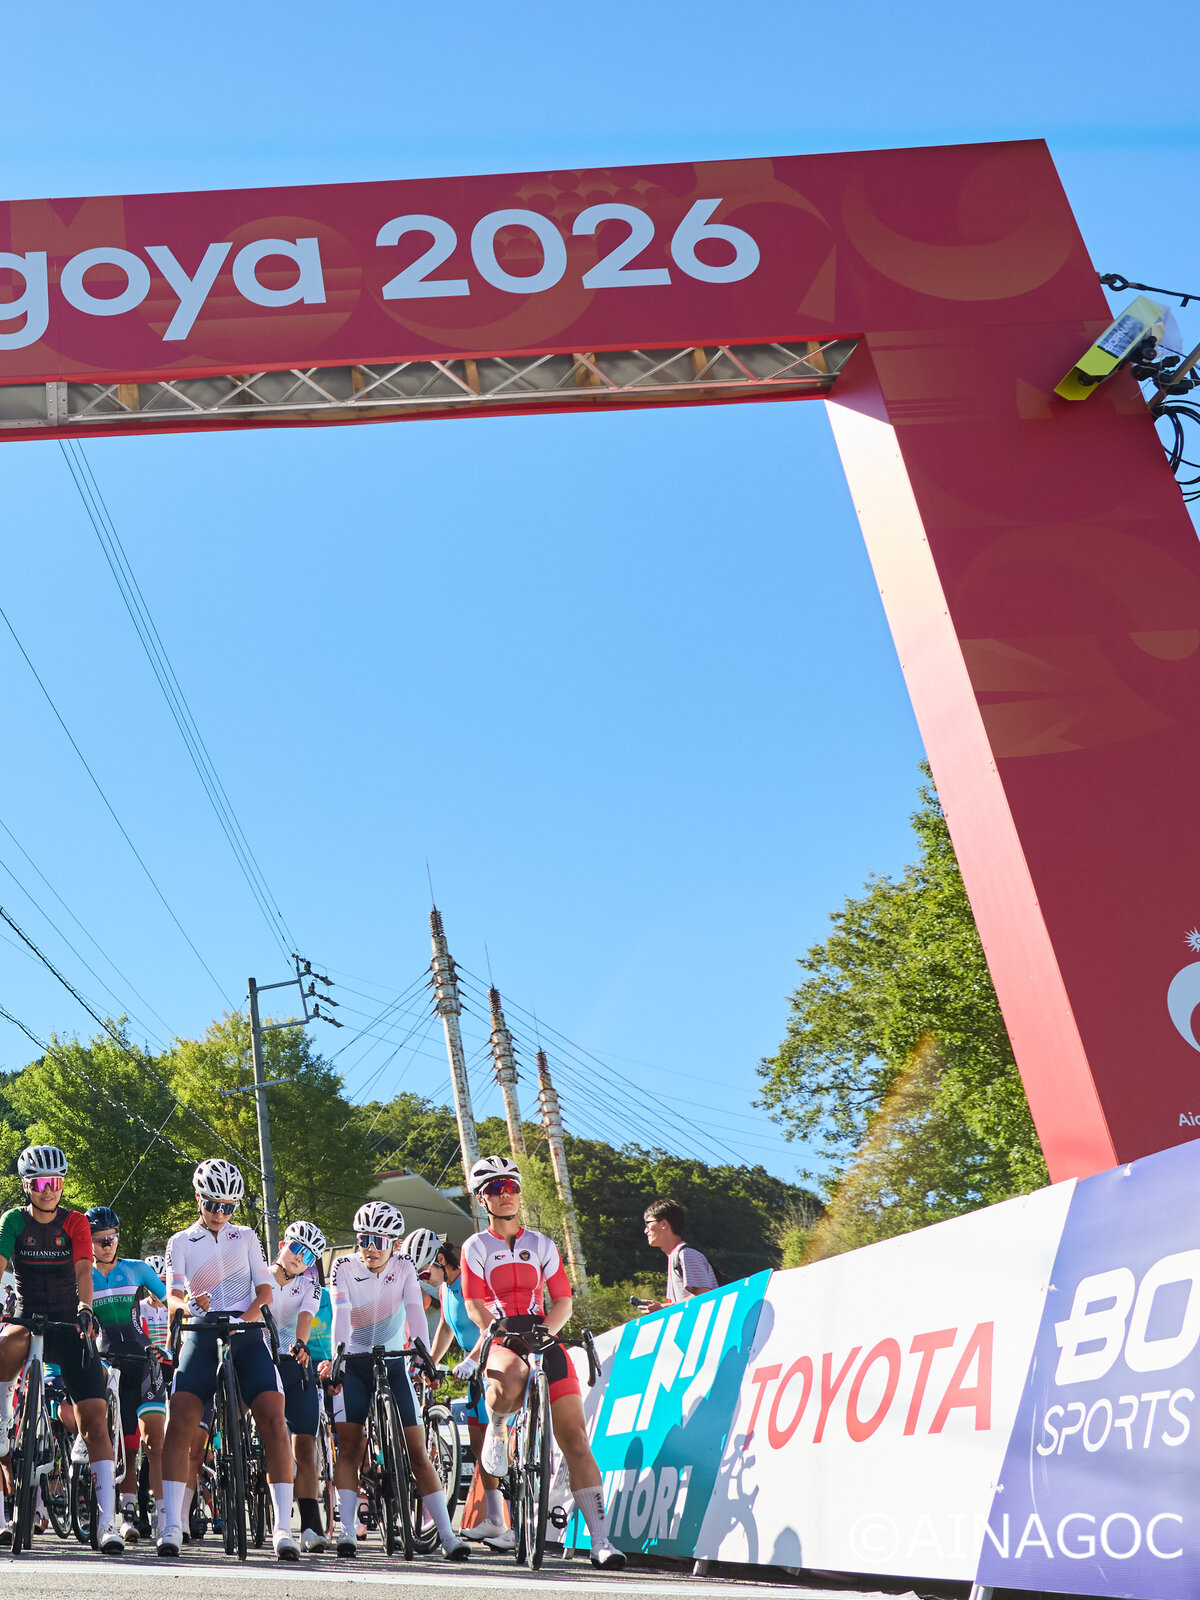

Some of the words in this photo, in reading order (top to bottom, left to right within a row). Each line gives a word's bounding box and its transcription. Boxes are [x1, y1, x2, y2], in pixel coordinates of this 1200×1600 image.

[375, 198, 760, 300] 2026
[19, 1249, 70, 1257] AFGHANISTAN
[606, 1292, 738, 1437] ニトリ
[745, 1321, 994, 1451] TOYOTA
[1036, 1387, 1196, 1457] SPORTS
